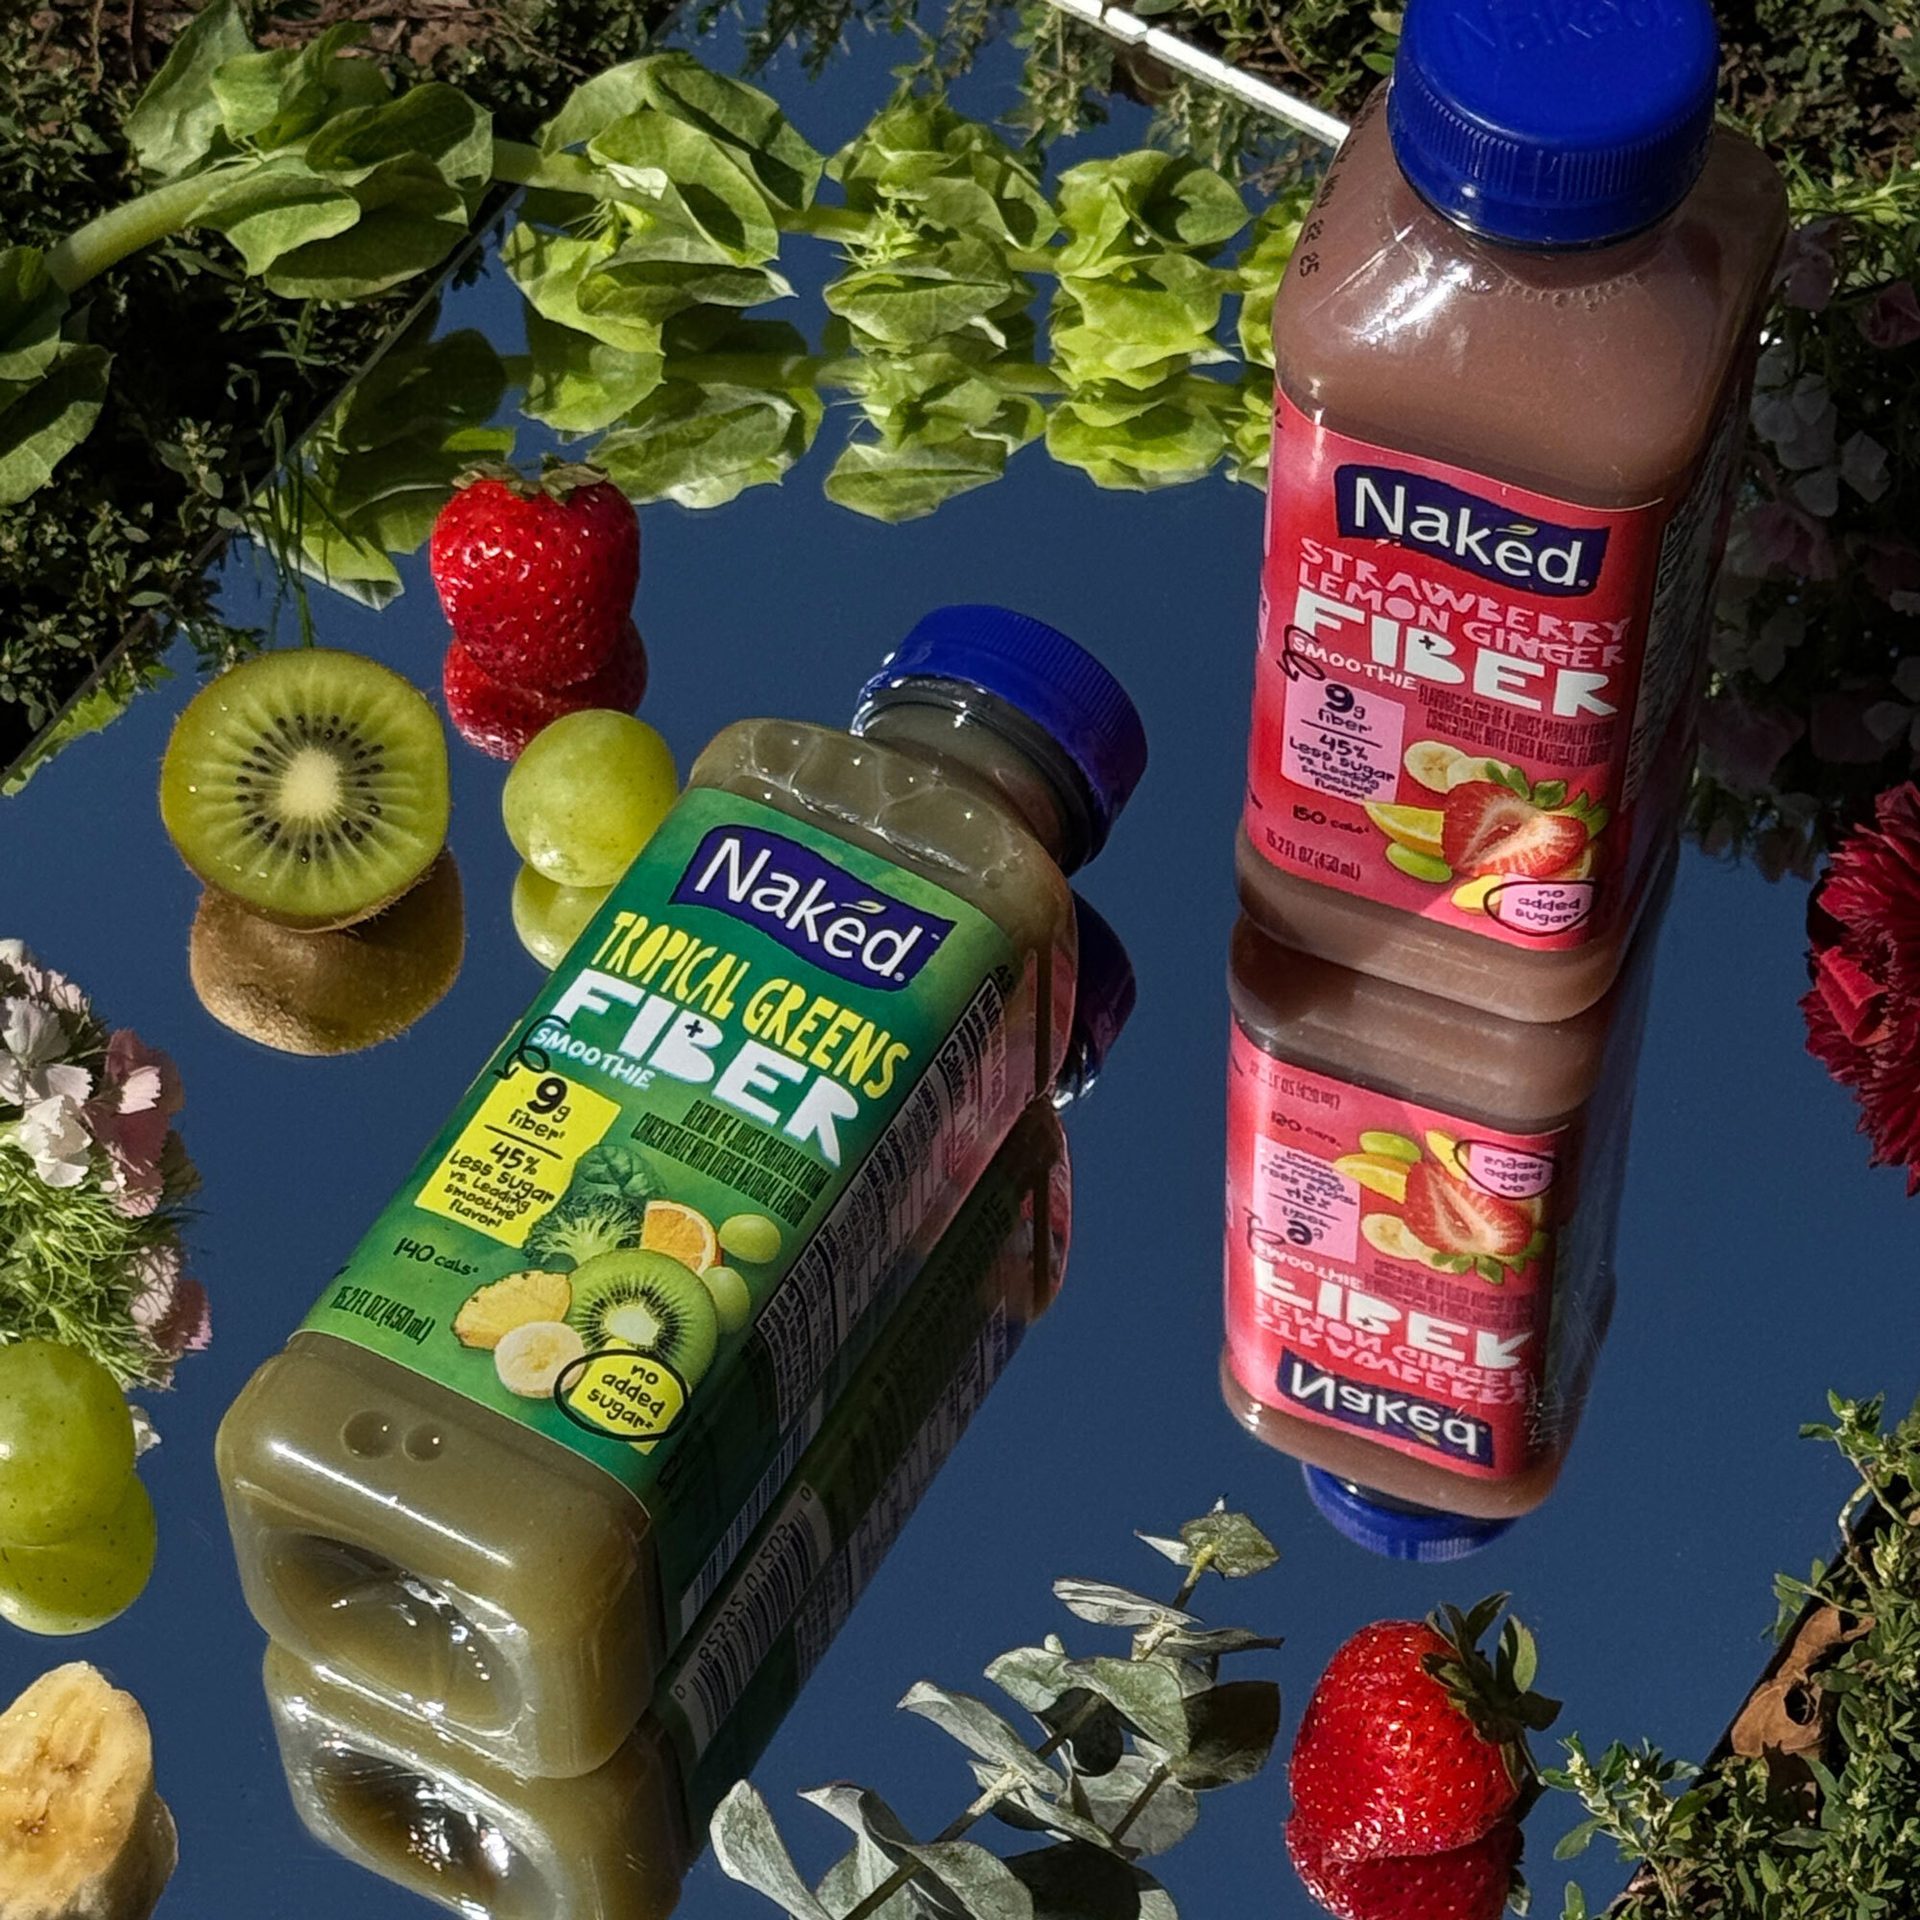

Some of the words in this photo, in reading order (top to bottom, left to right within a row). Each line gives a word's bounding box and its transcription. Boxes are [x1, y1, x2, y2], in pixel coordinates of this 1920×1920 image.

[1354, 477, 1583, 587] Naked
[1300, 538, 1632, 642] STRAWBERRY
[1299, 563, 1450, 634] LEMON
[1462, 620, 1626, 668] GINGER
[1292, 587, 1618, 718] FIBER
[1292, 637, 1418, 691] SMOOTHIE
[1325, 683, 1366, 720] 9g
[1319, 733, 1369, 761] 45%
[1339, 757, 1396, 782] sugar
[1293, 804, 1327, 825] 150
[695, 838, 923, 977] Naked
[1518, 897, 1581, 912] added
[1537, 889, 1565, 898] no
[590, 911, 752, 1023] TROPICAL
[741, 977, 911, 1100] GREENS
[530, 1024, 657, 1091] SMOOTHIE
[550, 968, 861, 1168] FIBER
[526, 1077, 572, 1123] 9g
[449, 1169, 468, 1185] vs.
[489, 1141, 541, 1176] 45%
[443, 1183, 517, 1221] smoothie
[496, 1171, 555, 1204] sugar
[393, 1237, 436, 1262] 140
[630, 1364, 659, 1385] no
[601, 1373, 666, 1419] added
